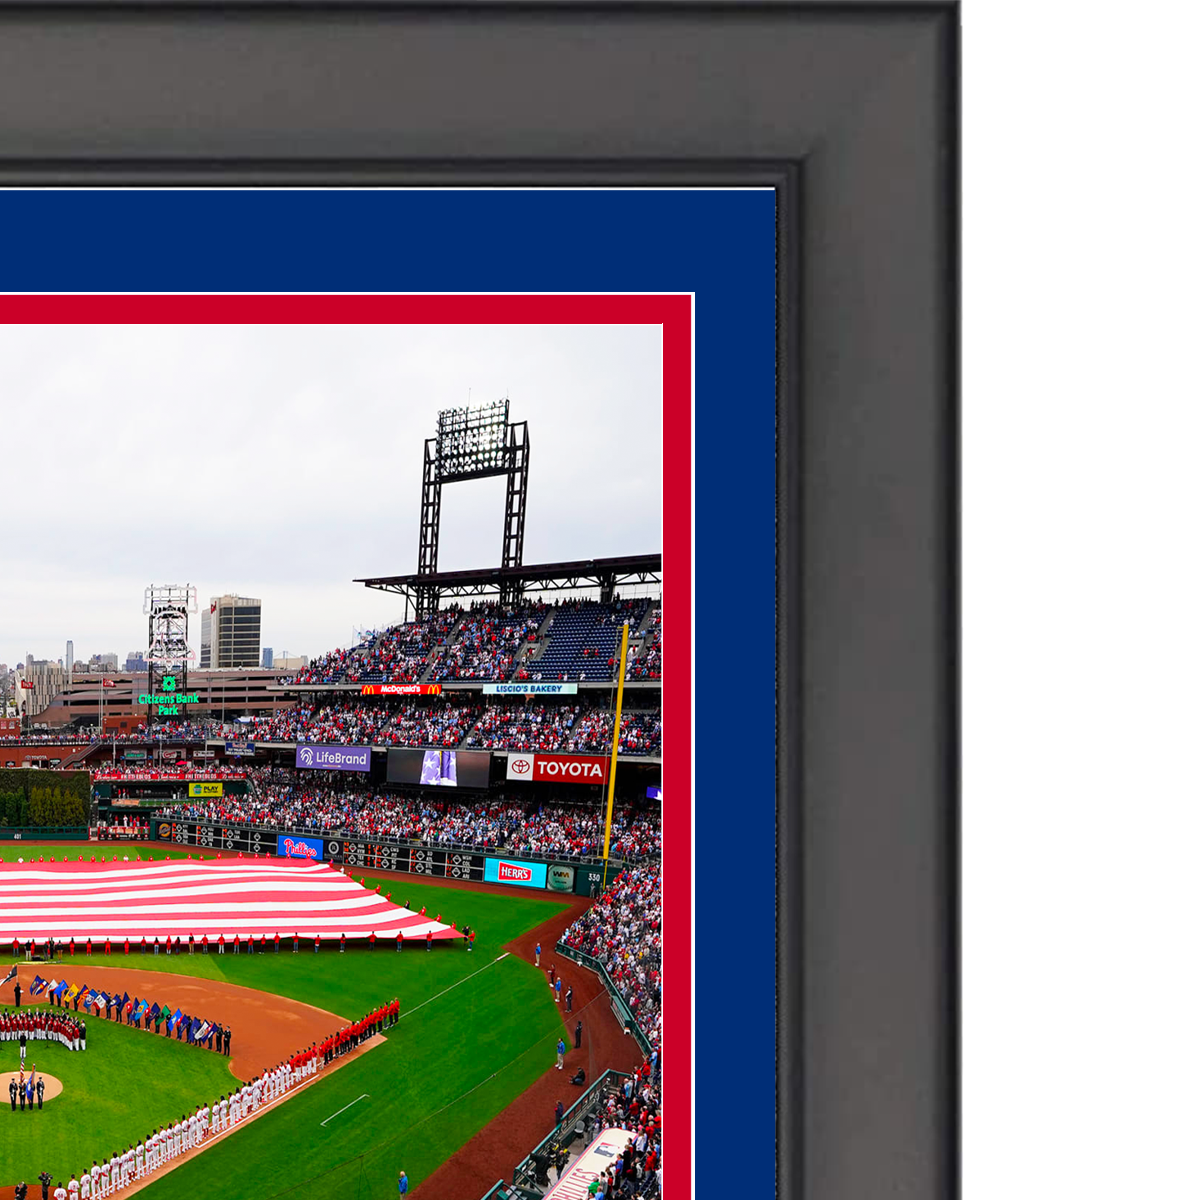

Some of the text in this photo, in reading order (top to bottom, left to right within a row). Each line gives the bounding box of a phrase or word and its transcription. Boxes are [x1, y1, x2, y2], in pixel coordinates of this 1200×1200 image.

[380, 685, 421, 693] McDonald's
[496, 684, 563, 693] LISCIO'S BAKERY
[138, 692, 199, 704] Citizens Bank
[158, 704, 179, 716] Park
[316, 751, 367, 765] LifeBrand
[537, 761, 603, 777] TOYOTA
[284, 838, 317, 857] Phillies
[501, 866, 528, 879] HERR'S
[588, 872, 600, 881] 330
